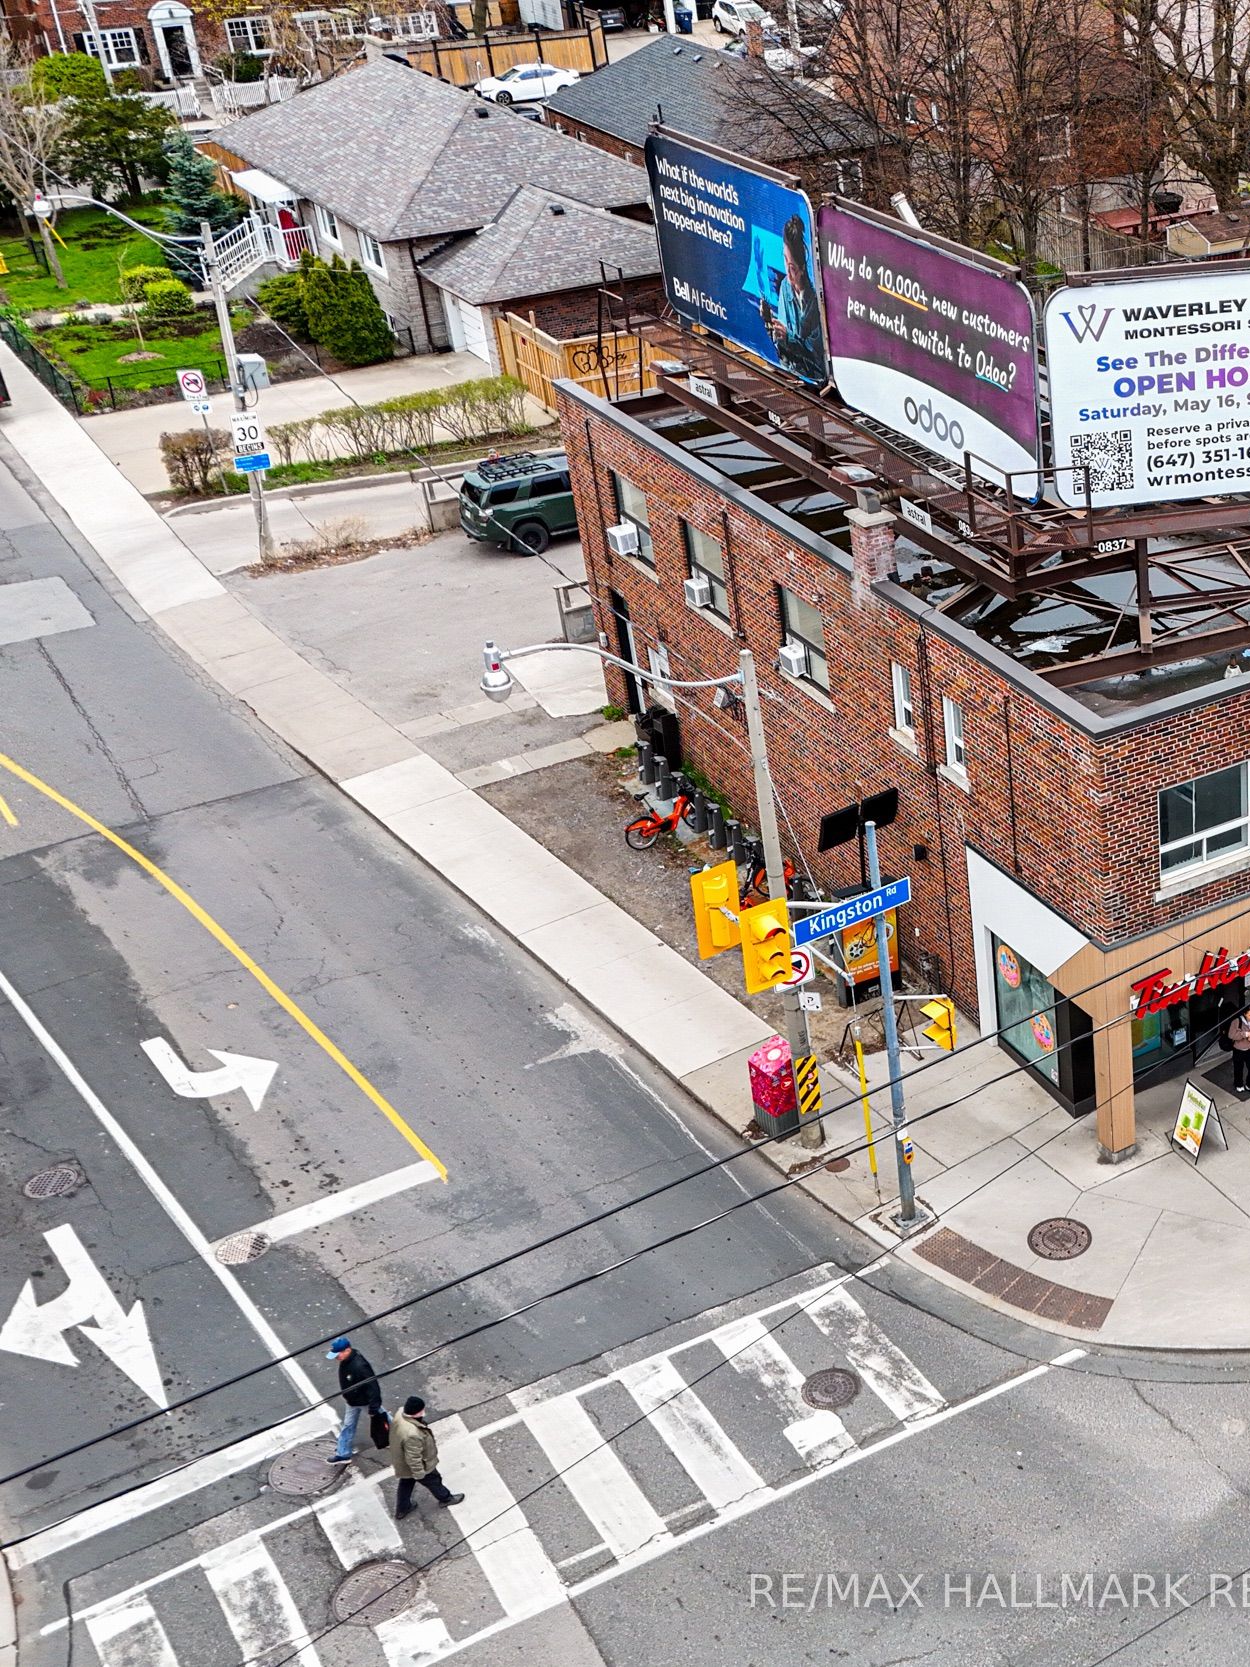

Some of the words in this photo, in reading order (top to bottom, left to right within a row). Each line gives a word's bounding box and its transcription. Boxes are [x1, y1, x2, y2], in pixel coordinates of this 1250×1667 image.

[655, 155, 681, 181] What
[681, 165, 688, 183] if
[689, 169, 705, 191] the
[705, 179, 739, 206] world's
[660, 184, 680, 203] next
[680, 187, 696, 215] big
[696, 194, 745, 232] innovation
[662, 202, 707, 238] happened
[707, 220, 733, 249] here?
[673, 276, 691, 302] Bell
[691, 287, 700, 306] AI
[700, 291, 728, 320] Fabric
[828, 241, 855, 280] Why
[858, 255, 872, 280] do
[877, 266, 929, 306] 10,000+
[932, 296, 958, 320] new
[962, 310, 1030, 353] customers
[1122, 298, 1247, 322] WAVERLEY
[847, 296, 866, 318] per
[870, 307, 908, 340] month
[912, 328, 953, 361] switch
[957, 343, 971, 368] to
[976, 351, 1016, 389] Odoo?
[1124, 320, 1242, 340] MONTESSORI
[1096, 356, 1138, 372] See
[1145, 350, 1187, 367] The
[695, 383, 712, 399] astral
[1114, 371, 1195, 398] OPEN
[1079, 402, 1167, 422] Saturday,
[1173, 397, 1211, 414] May
[1217, 393, 1240, 409] 16,
[237, 425, 258, 442] 30
[904, 396, 965, 450] odoo
[1147, 423, 1200, 437] Reserve
[1205, 423, 1212, 431] a
[1147, 437, 1191, 450] before
[1195, 435, 1232, 449] spots
[1147, 451, 1195, 472] (647)
[906, 505, 927, 527] astral
[1098, 538, 1126, 554] 0837
[809, 895, 882, 935] Kingston
[886, 886, 897, 896] Rd
[1131, 967, 1190, 1019] Tim
